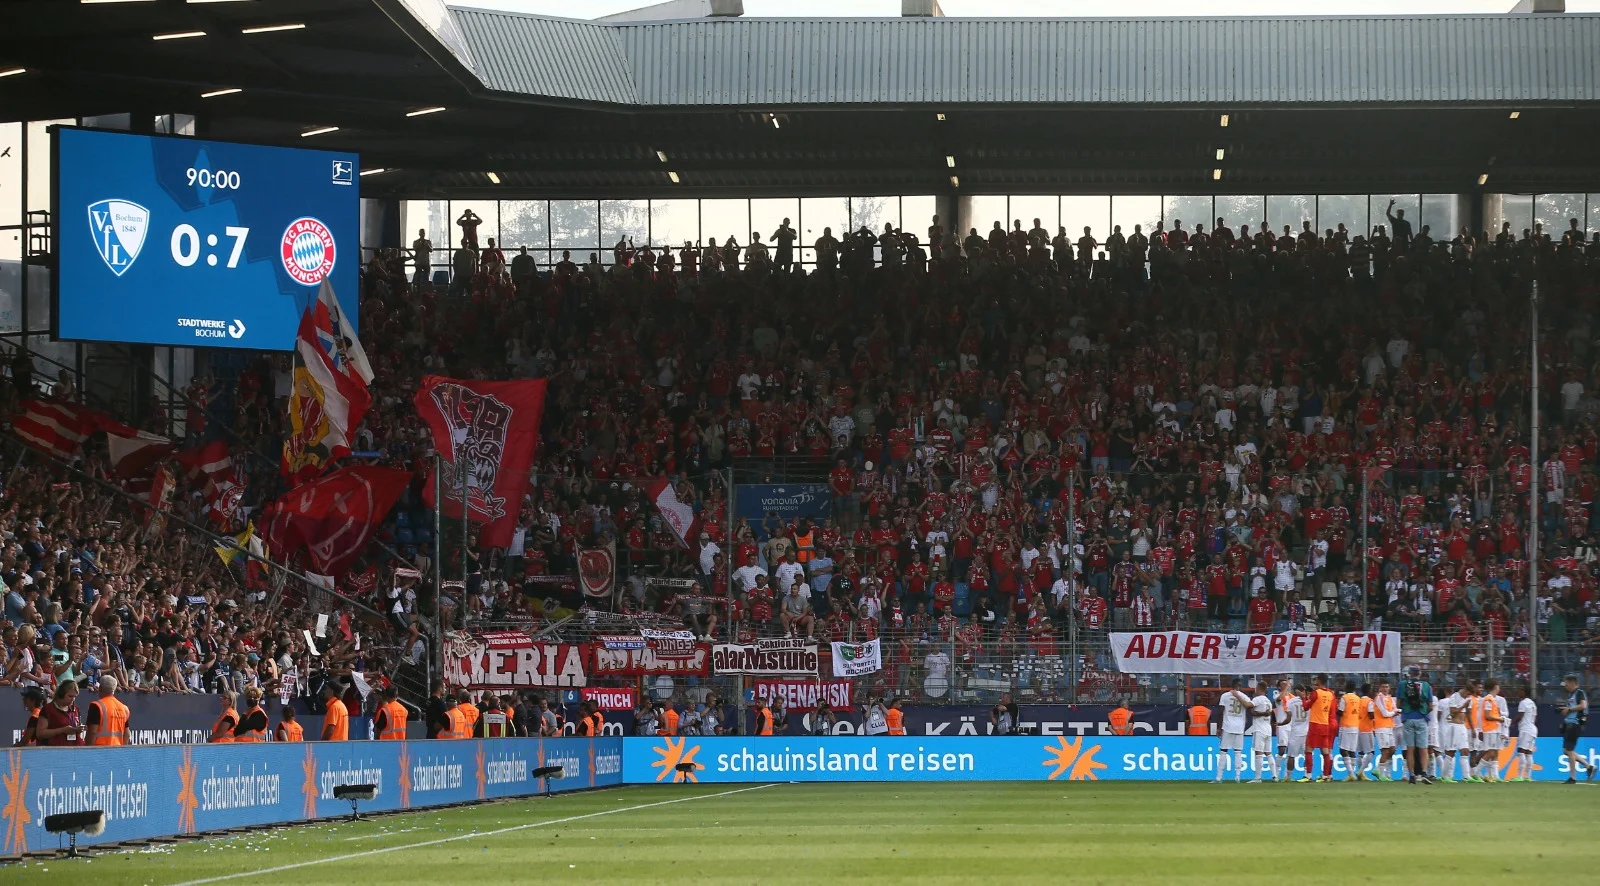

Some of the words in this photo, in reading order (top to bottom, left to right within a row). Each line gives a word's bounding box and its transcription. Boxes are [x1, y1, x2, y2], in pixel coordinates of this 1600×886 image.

[186, 168, 240, 189] 90:00
[115, 213, 143, 222] Bochum
[171, 223, 249, 268] 0:7
[285, 230, 297, 245] FC
[296, 222, 333, 248] BAYERN
[177, 318, 226, 328] STADTWERKE
[195, 329, 226, 338] BOCHUM
[759, 640, 791, 649] Sektion
[1124, 634, 1221, 660] ADLER
[1245, 633, 1388, 659] BRETTEN
[568, 690, 574, 700] 6
[586, 690, 631, 707] ZÜRICH
[717, 747, 877, 771] schauinsland
[888, 747, 973, 771] reisen
[116, 769, 147, 819] reisen
[202, 764, 254, 811] schauinsland
[256, 763, 280, 805] reisen
